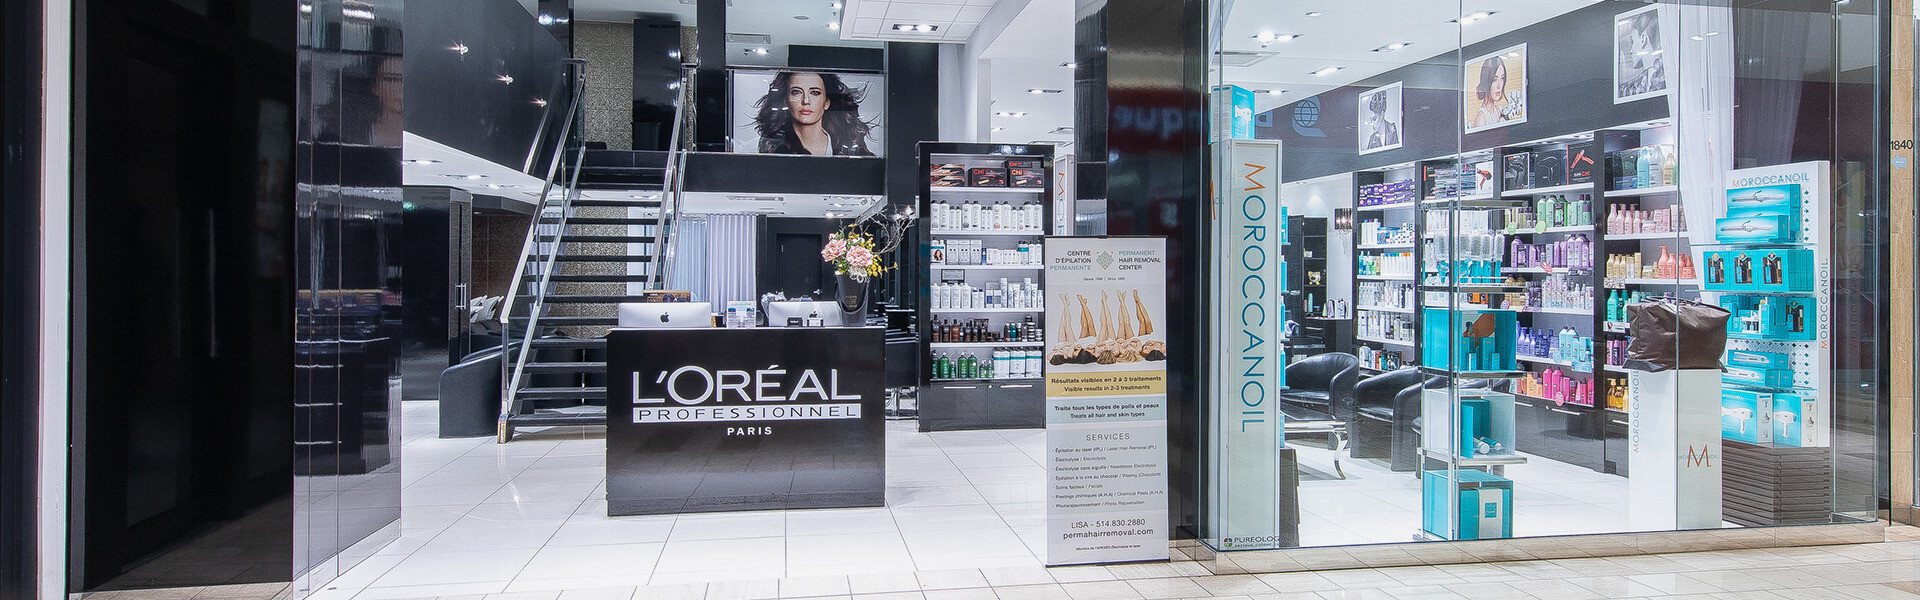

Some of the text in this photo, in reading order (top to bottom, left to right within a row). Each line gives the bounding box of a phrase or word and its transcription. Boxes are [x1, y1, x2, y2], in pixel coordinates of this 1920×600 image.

[1890, 140, 1913, 150] 1840
[1732, 172, 1810, 188] MOROCCANOIL
[1055, 256, 1091, 264] D'ÉPILATION
[1241, 163, 1267, 433] MOROCCANOIL
[1820, 261, 1829, 350] MOROCCANOIL
[632, 364, 862, 405] L'ORÉAL
[638, 406, 857, 421] PROFESSIONNEL
[1632, 370, 1640, 453] MOROCCANOIL
[727, 426, 773, 436] PARIS
[1085, 433, 1130, 441] SERVICES
[1096, 519, 1146, 528] 514.830.2880
[1063, 529, 1154, 540] permahairremoval.com
[1234, 535, 1280, 543] PUREOLOG
